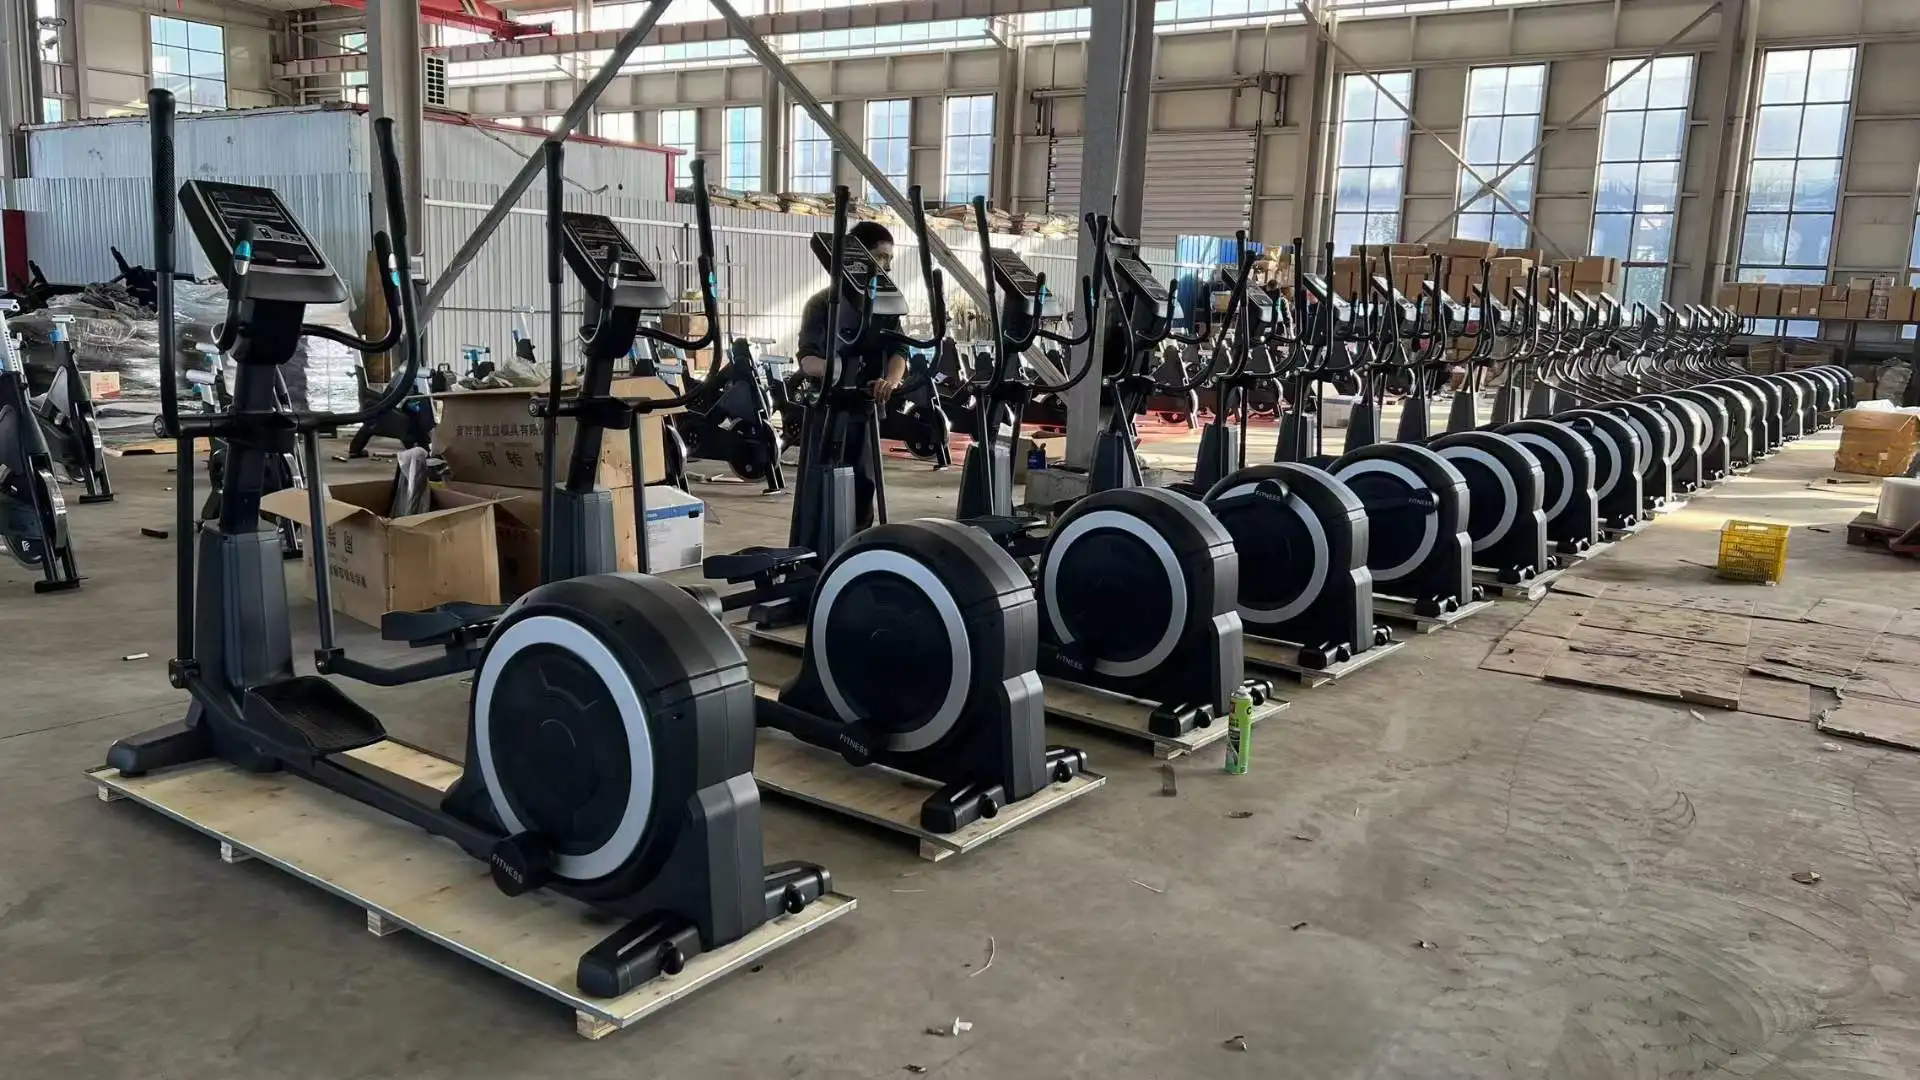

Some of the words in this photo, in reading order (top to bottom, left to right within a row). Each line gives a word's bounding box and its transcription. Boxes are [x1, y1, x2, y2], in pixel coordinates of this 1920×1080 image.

[1255, 490, 1280, 501] FITNESS
[1056, 652, 1083, 670] FITNESS
[840, 732, 868, 756] FITNESS
[492, 853, 523, 884] FITNESS
